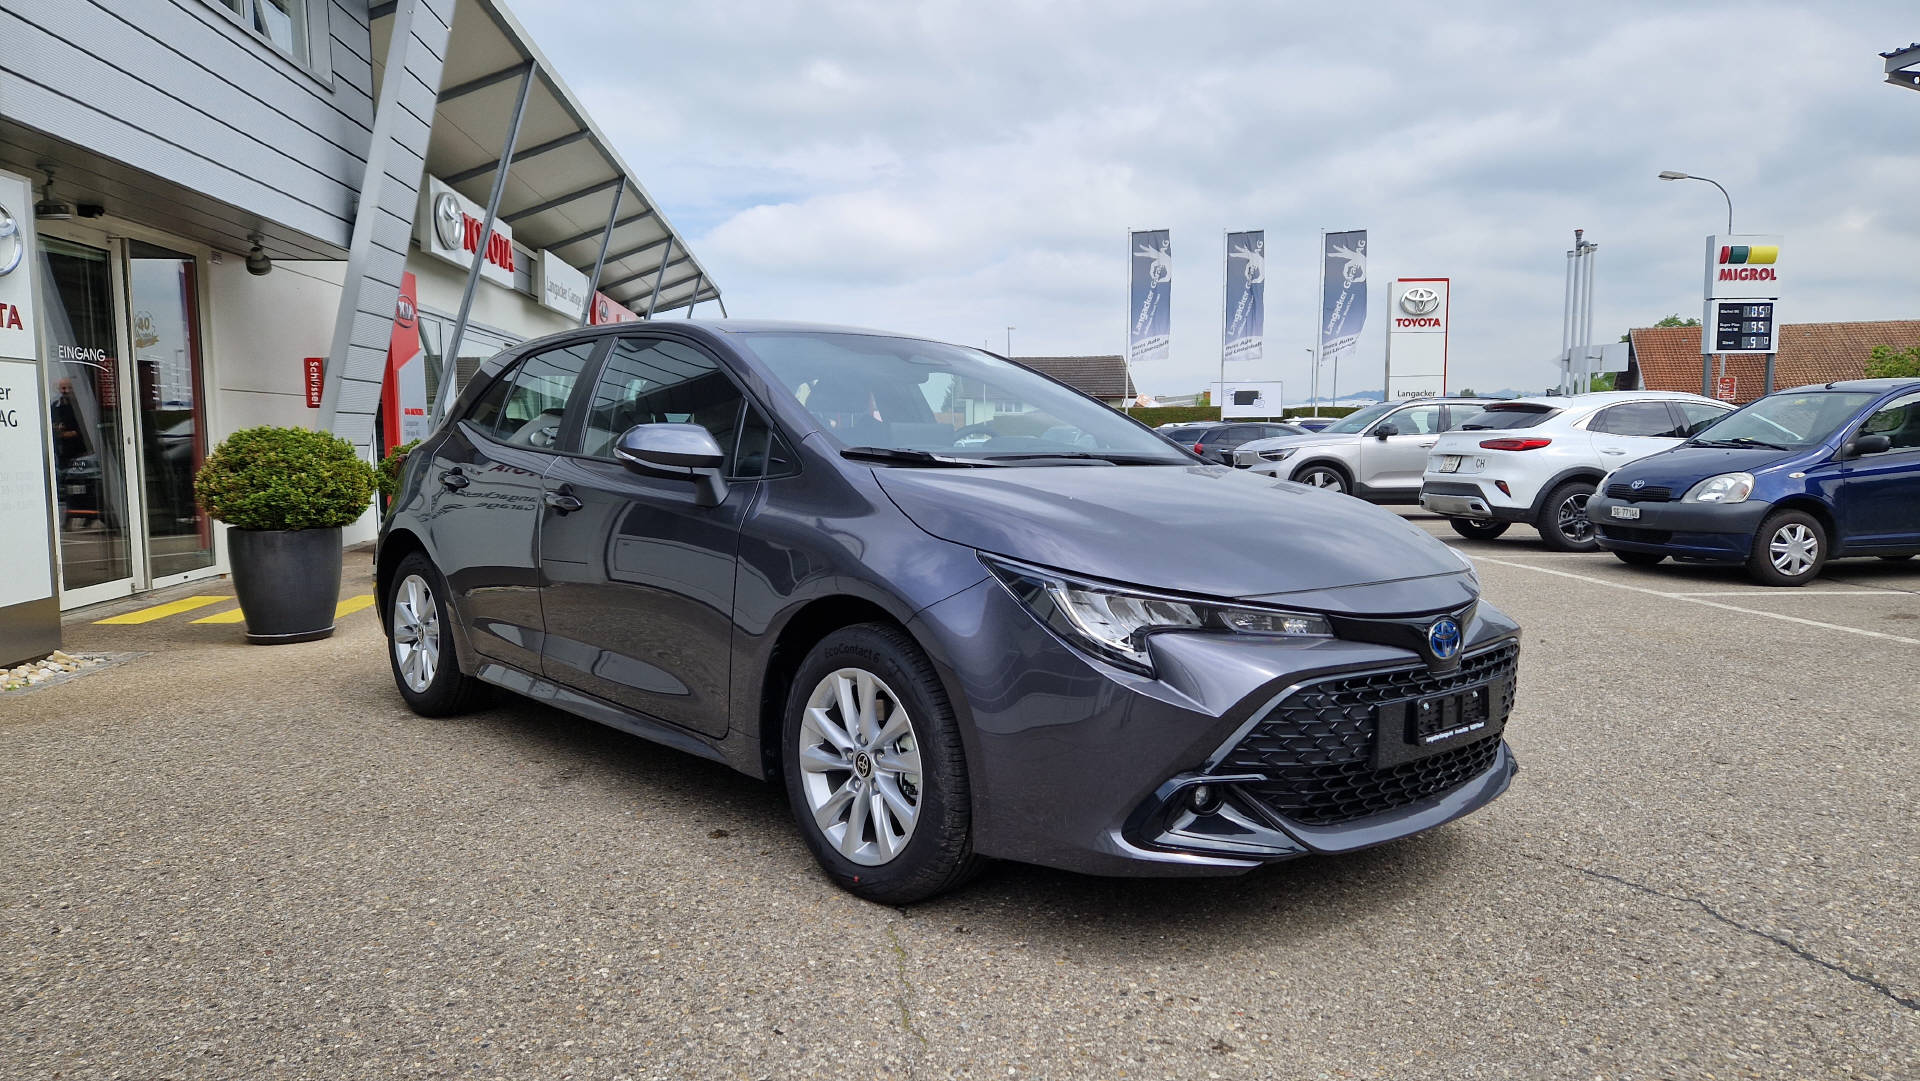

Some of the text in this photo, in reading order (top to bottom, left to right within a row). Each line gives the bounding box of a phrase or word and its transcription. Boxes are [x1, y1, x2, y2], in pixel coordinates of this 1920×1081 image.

[462, 211, 515, 272] TOOTA
[1719, 268, 1777, 281] MIGROL
[1396, 318, 1441, 328] TOYOTA
[58, 345, 106, 361] EINGANG
[310, 361, 321, 405] Schlüssel
[1397, 389, 1436, 398] Langacker
[1475, 458, 1486, 469] CH
